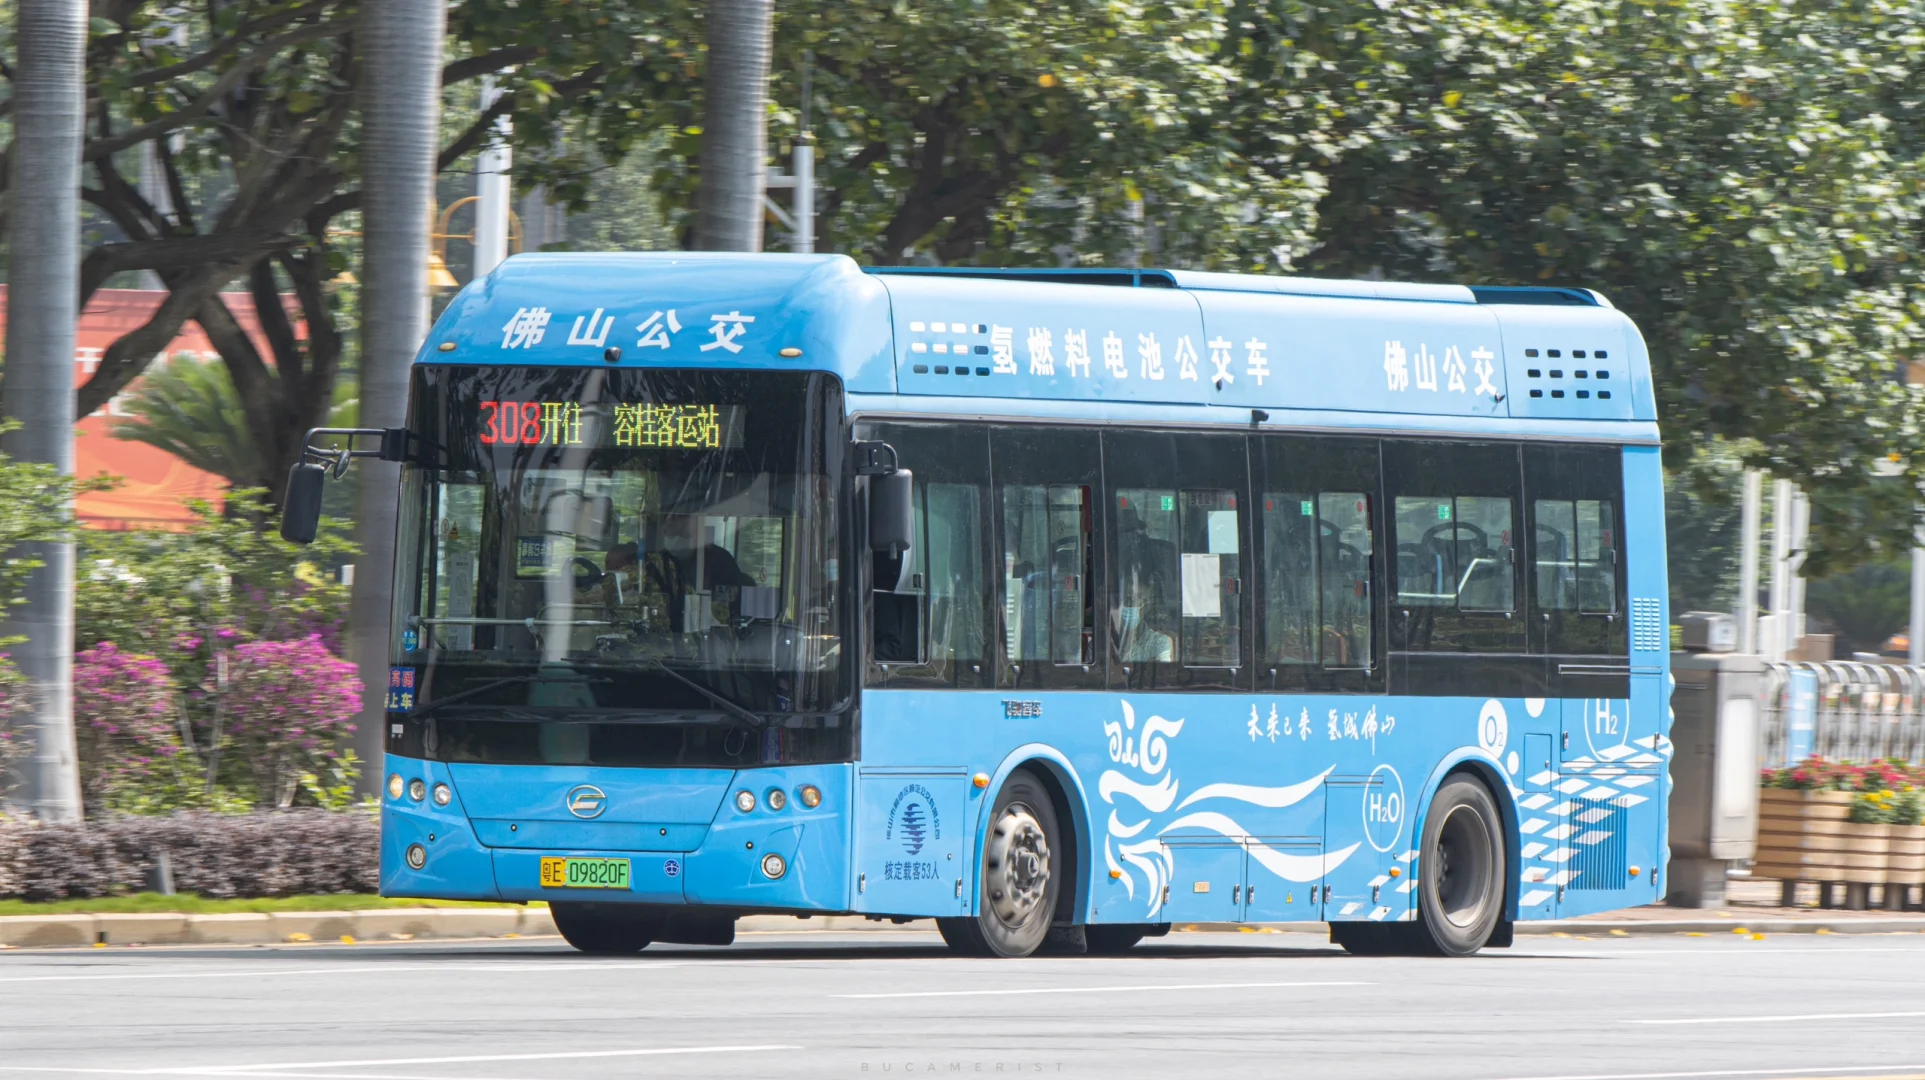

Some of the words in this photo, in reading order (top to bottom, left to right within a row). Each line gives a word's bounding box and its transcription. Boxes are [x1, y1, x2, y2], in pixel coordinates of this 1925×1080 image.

[501, 306, 756, 354] 佛山公交
[990, 324, 1270, 386] 氢燃料电池公交车
[1383, 340, 1498, 396] 佛山公交
[612, 402, 720, 447] 容桂客运站
[884, 861, 940, 881] 核定载客53人
